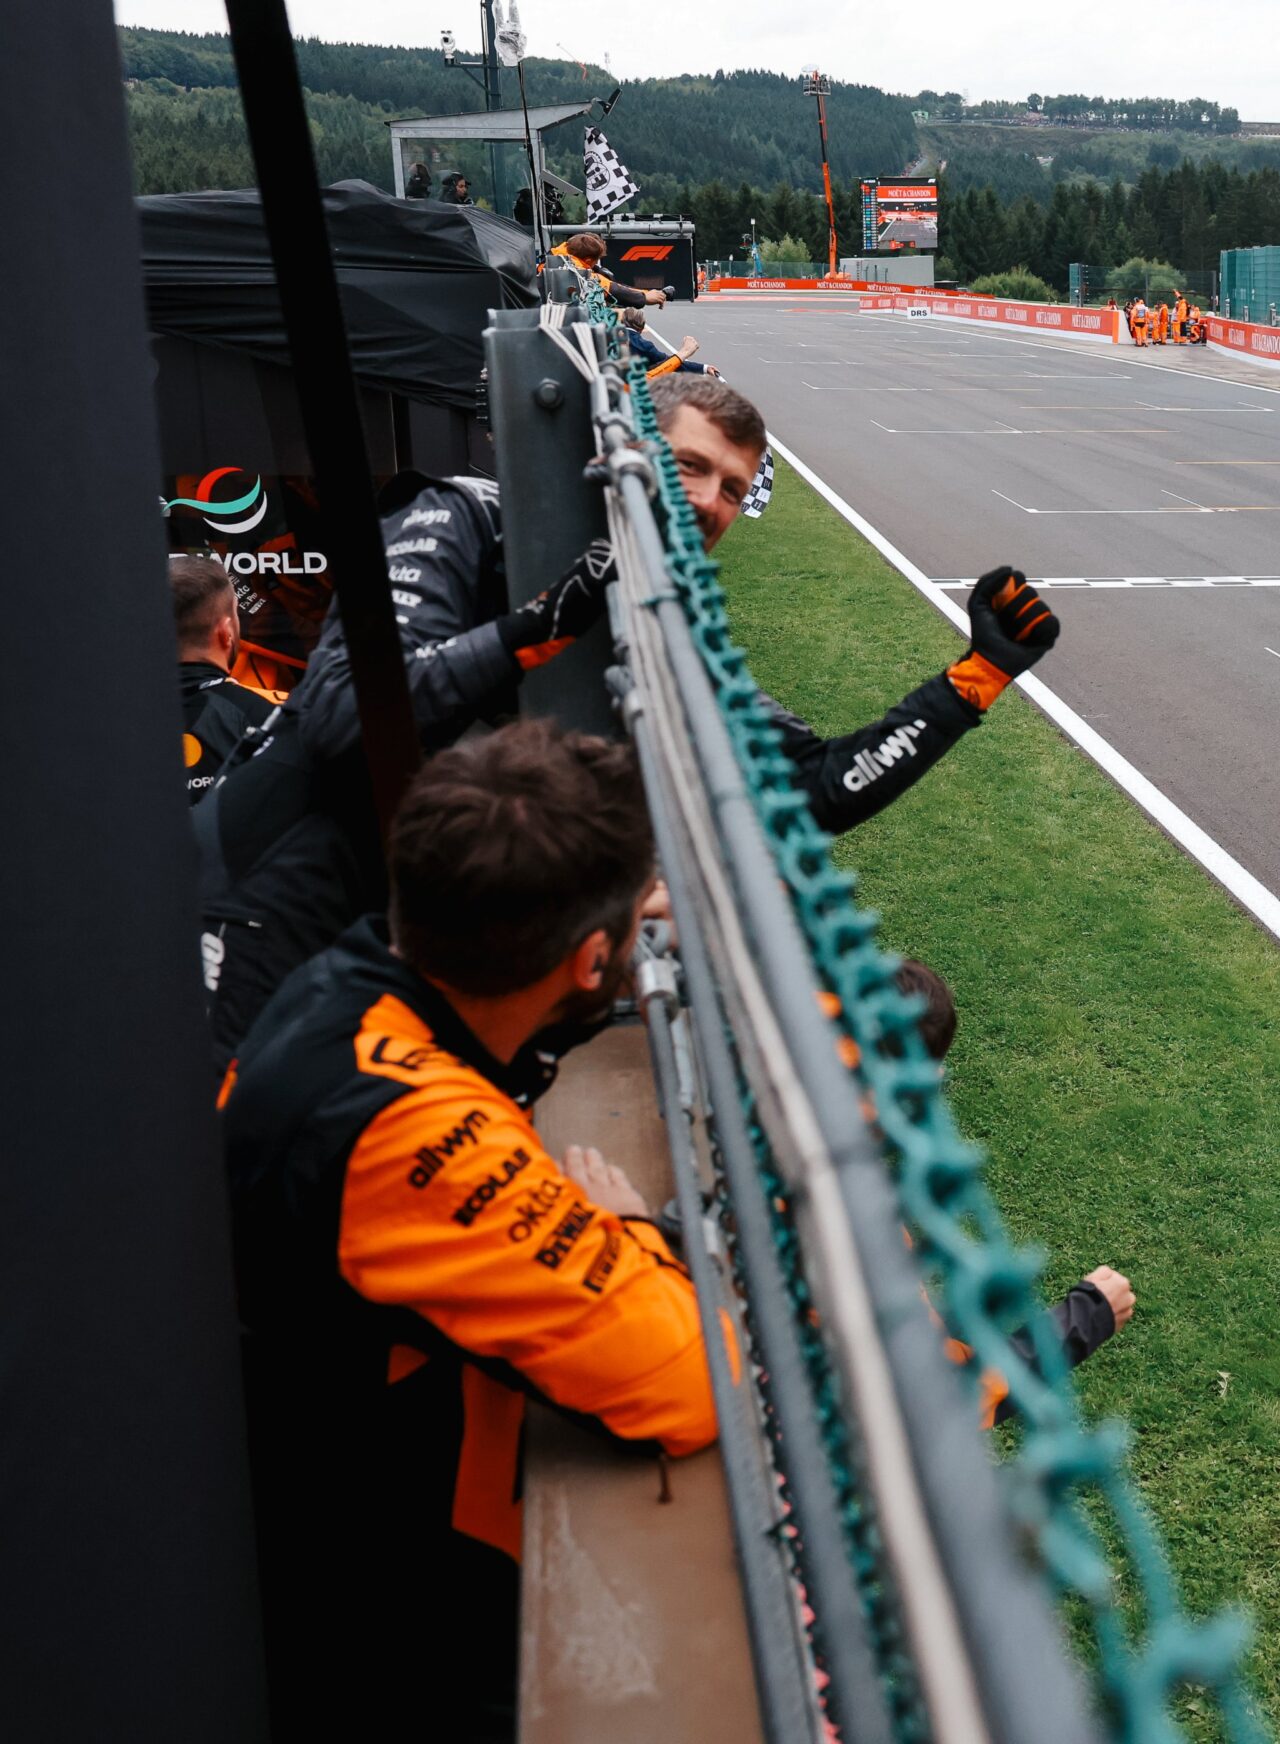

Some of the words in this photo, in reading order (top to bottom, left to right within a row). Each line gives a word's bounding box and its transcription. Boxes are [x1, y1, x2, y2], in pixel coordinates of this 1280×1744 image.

[388, 565, 422, 583] kta
[407, 1109, 491, 1190] allwyn
[508, 1180, 563, 1243] okta
